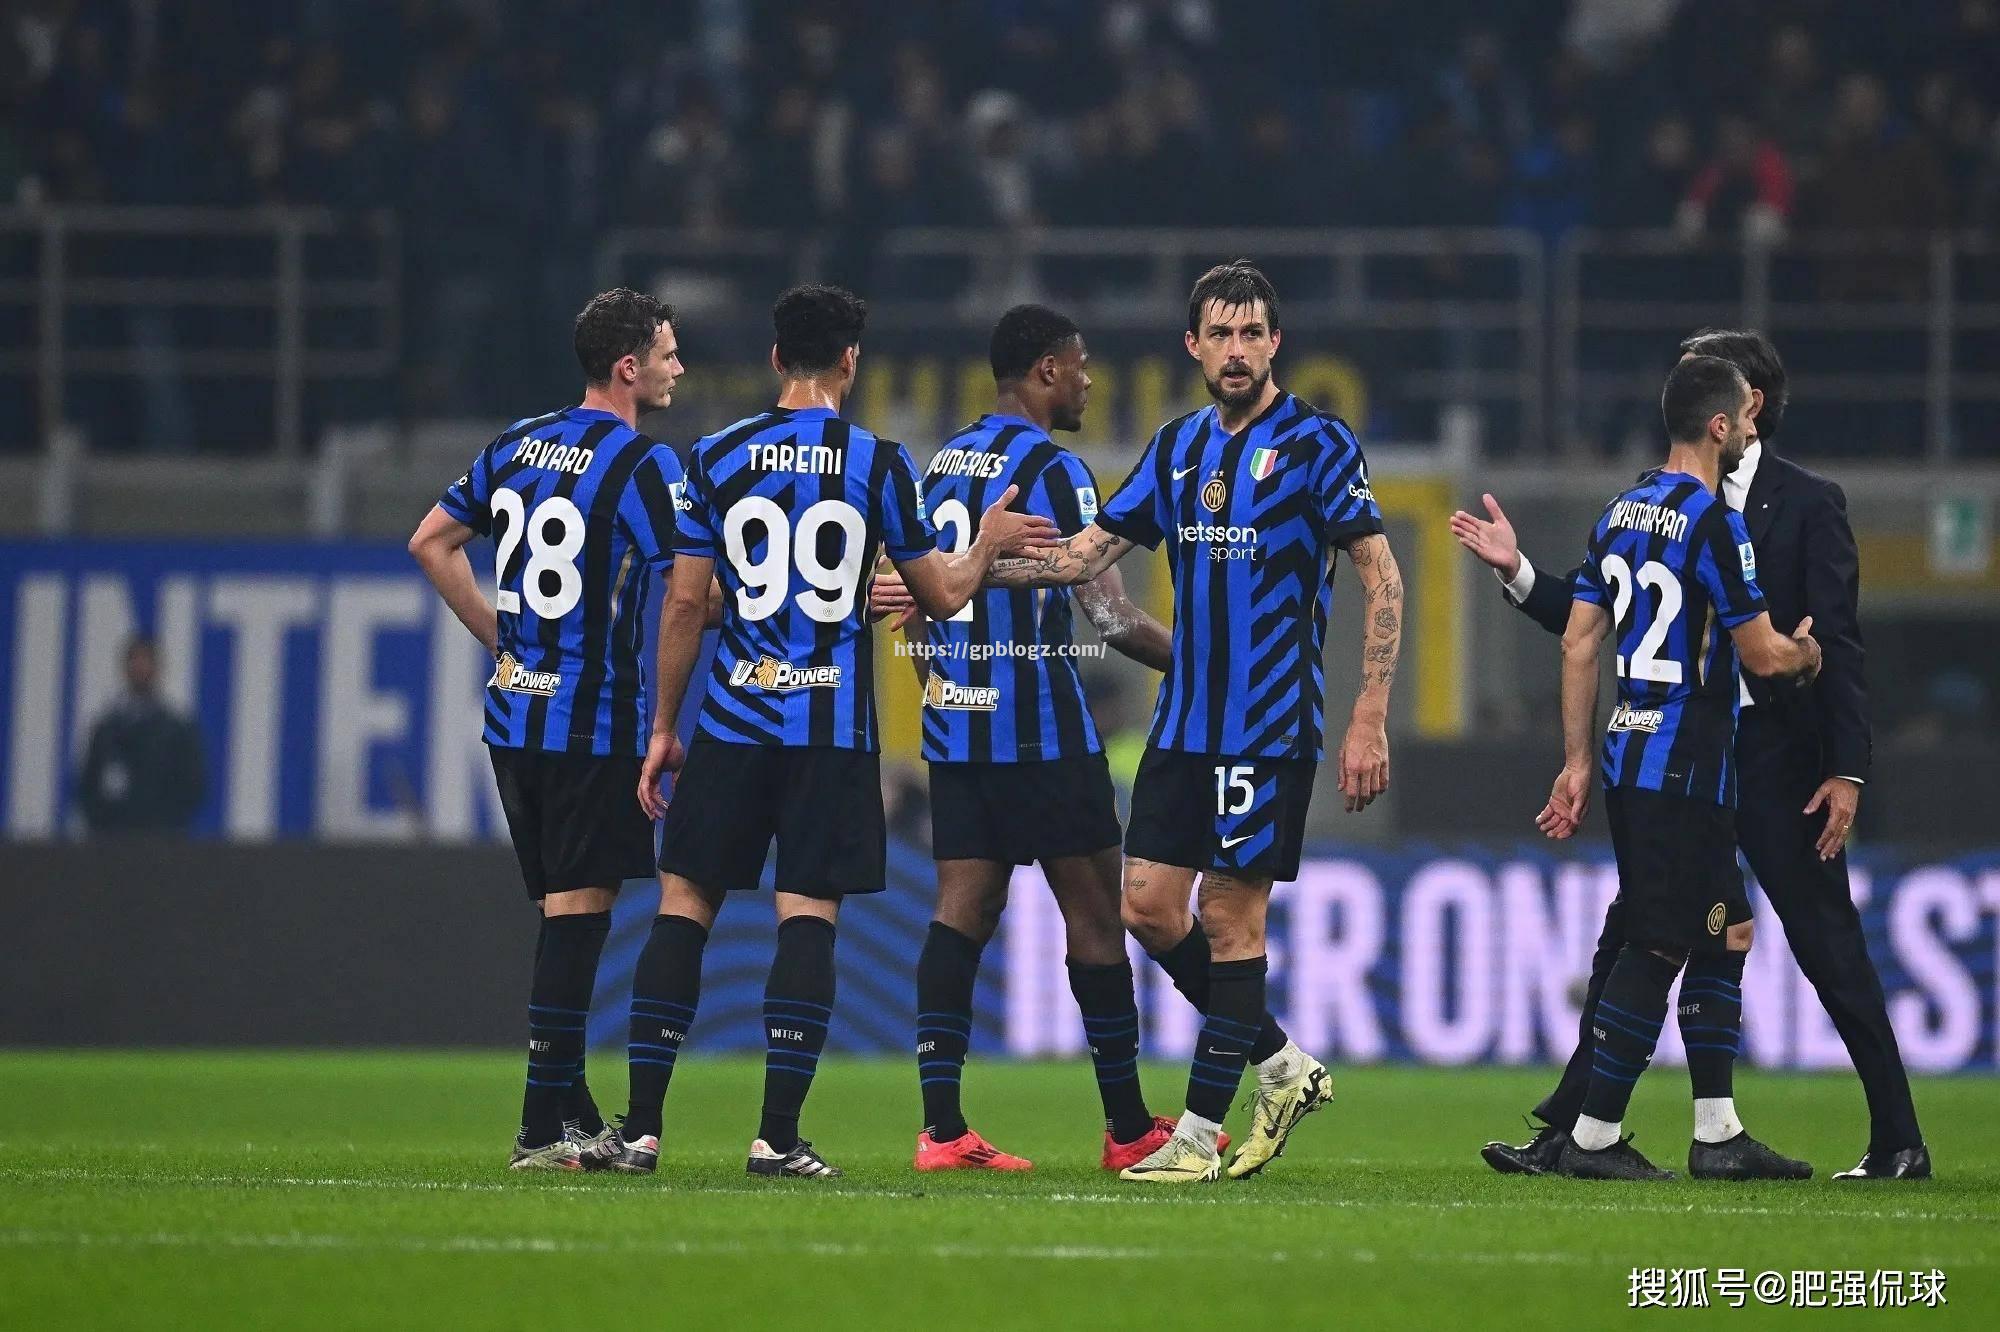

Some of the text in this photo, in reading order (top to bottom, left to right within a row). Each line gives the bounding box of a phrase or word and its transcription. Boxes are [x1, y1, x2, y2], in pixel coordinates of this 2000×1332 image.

[511, 436, 594, 475] PAVARD
[747, 444, 842, 475] TAREMI
[490, 487, 586, 620] 28
[723, 495, 867, 623] 99
[1601, 553, 1683, 684] 22
[509, 664, 561, 692] Power
[773, 662, 841, 688] Power
[941, 681, 1000, 706] Power
[1214, 766, 1254, 815] 15
[1677, 1003, 1701, 1016] NTER
[529, 1039, 551, 1052] NTER
[770, 1028, 803, 1041] INTER
